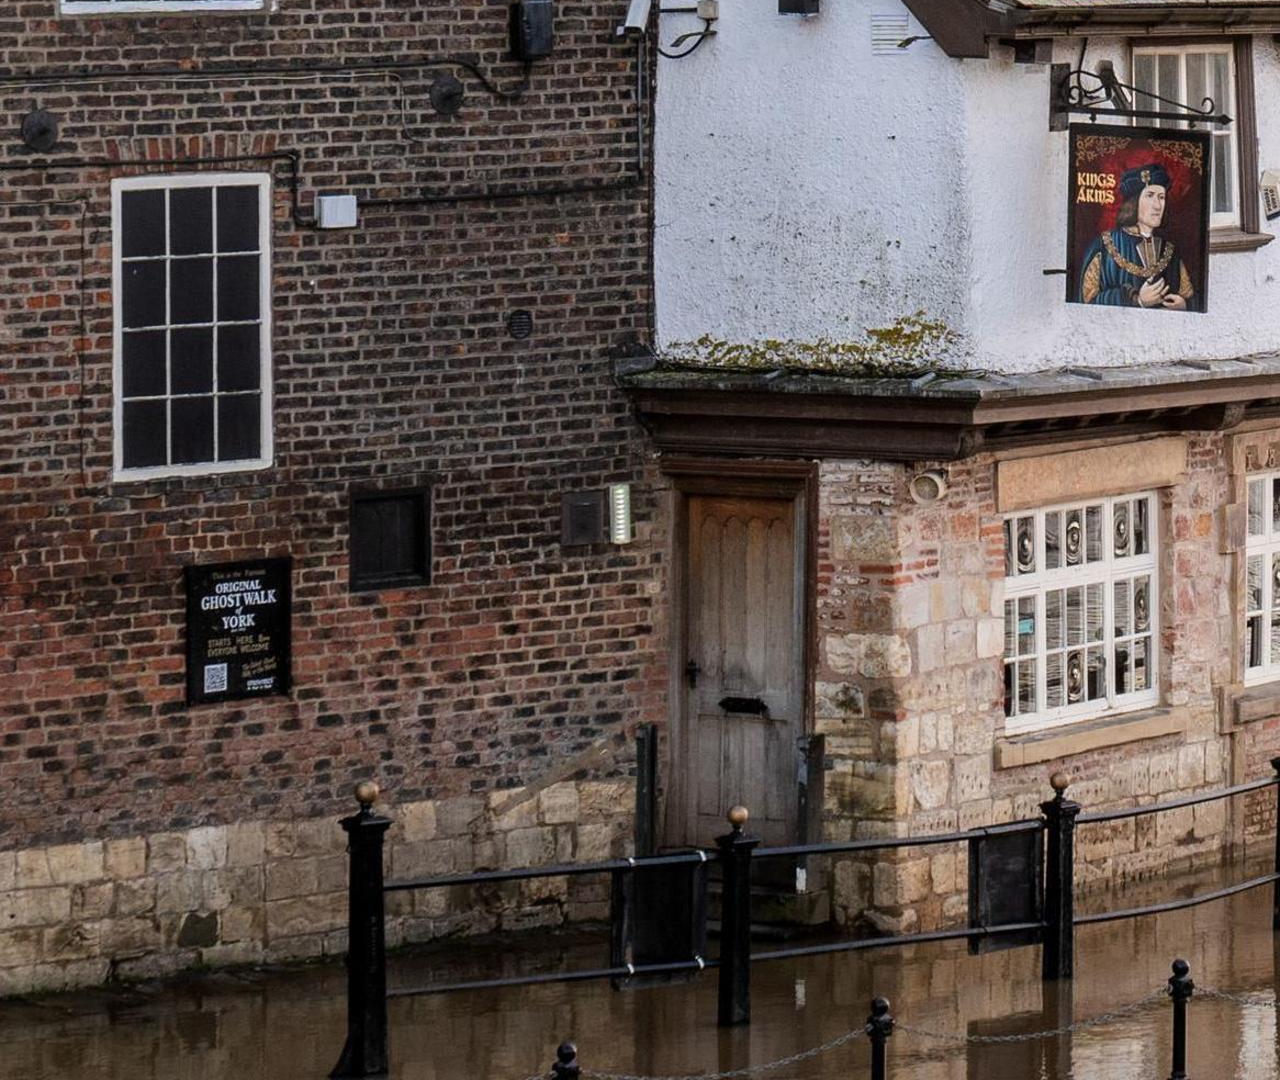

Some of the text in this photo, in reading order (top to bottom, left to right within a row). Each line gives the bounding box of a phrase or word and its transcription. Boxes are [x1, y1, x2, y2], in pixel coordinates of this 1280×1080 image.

[1077, 172, 1116, 187] KINGS
[1077, 189, 1115, 204] ARMS
[215, 579, 262, 594] ORIGINAL
[201, 589, 277, 610] GHOST WALK
[235, 606, 243, 615] of
[222, 614, 256, 630] YORK
[207, 638, 231, 649] STARTS
[236, 635, 253, 646] HERE
[207, 643, 270, 658] EVERYONE WELCOME
